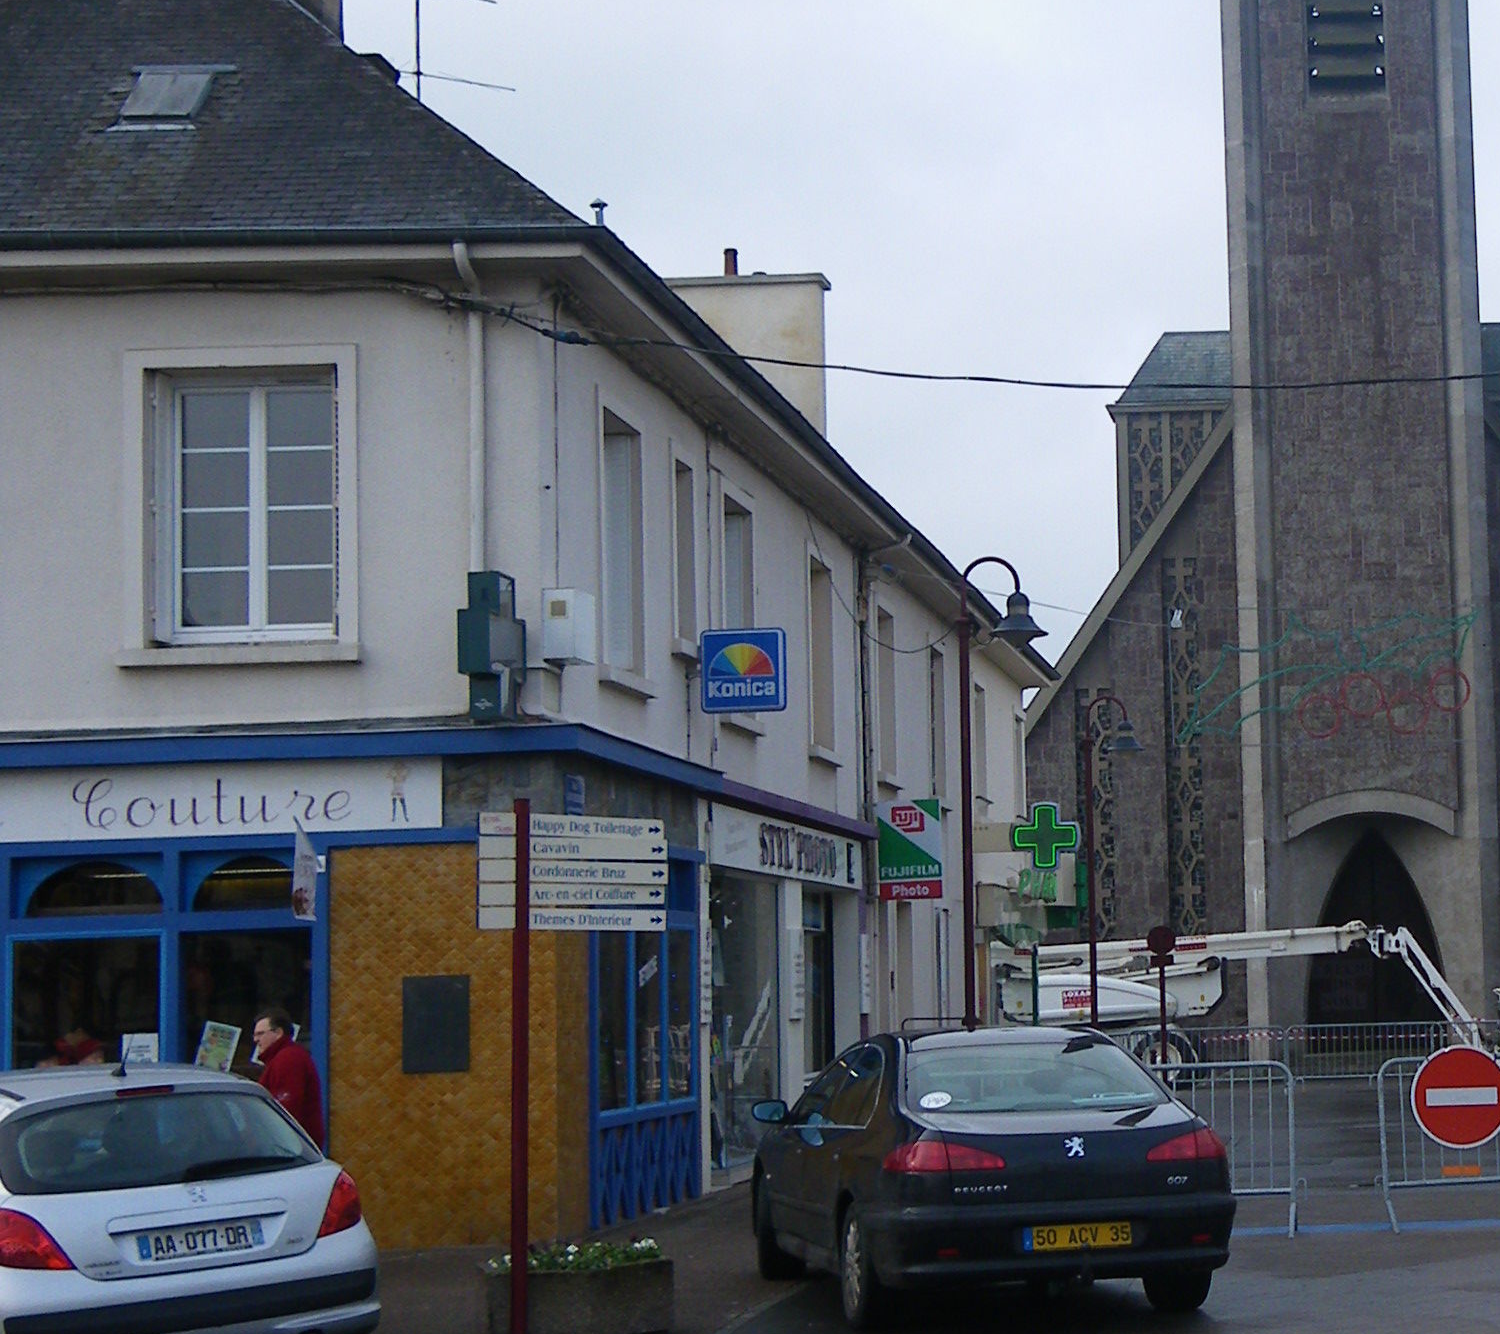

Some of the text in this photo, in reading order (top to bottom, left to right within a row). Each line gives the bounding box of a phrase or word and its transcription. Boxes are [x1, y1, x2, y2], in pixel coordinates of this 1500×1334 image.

[707, 678, 776, 699] Konica
[72, 777, 353, 831] Couture
[532, 819, 565, 834] Happy
[569, 820, 590, 835] Dog
[593, 822, 644, 837] Toilettage
[532, 842, 580, 854] Cavavin
[532, 865, 627, 879] Cordonnerie Bruz
[881, 864, 940, 878] FUJIFILM
[595, 888, 637, 900] Coiffure
[892, 883, 930, 897] Photo
[533, 913, 575, 925] Themes
[1166, 1175, 1188, 1185] 607
[1035, 1223, 1130, 1246] 50 ACV 35
